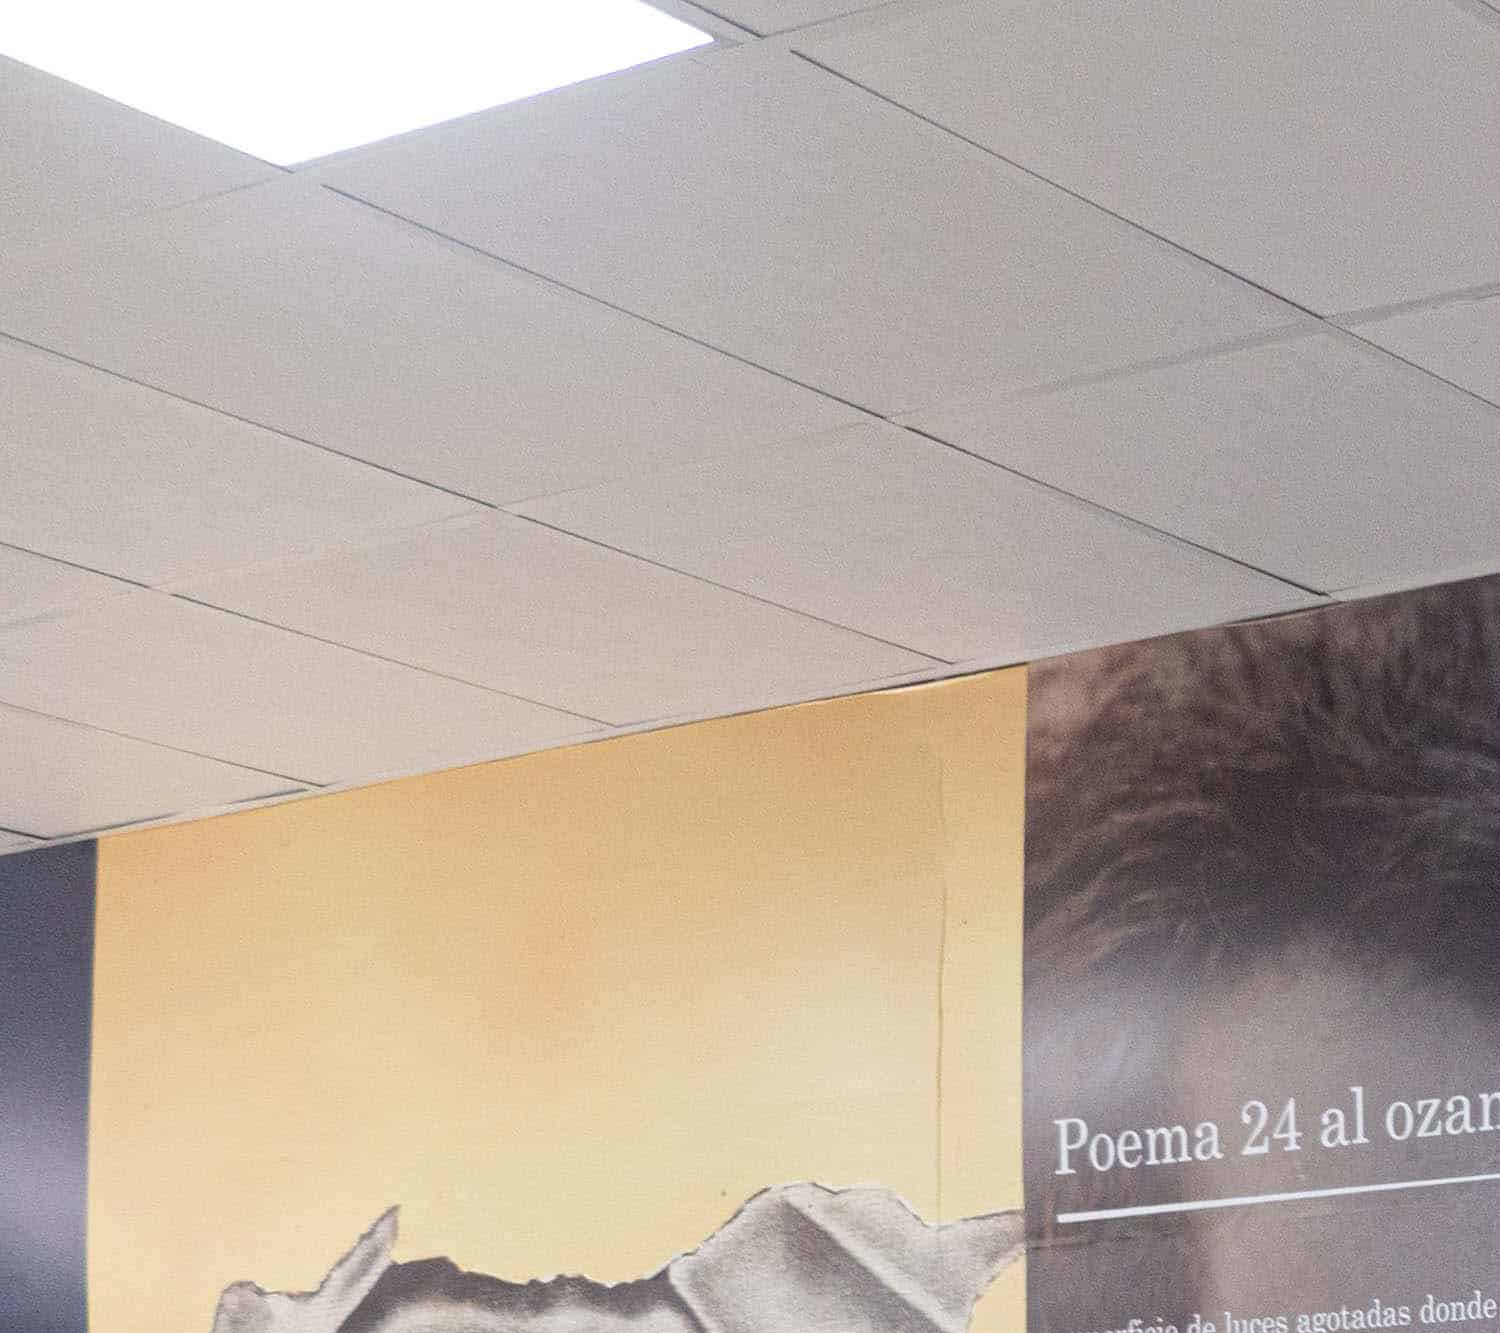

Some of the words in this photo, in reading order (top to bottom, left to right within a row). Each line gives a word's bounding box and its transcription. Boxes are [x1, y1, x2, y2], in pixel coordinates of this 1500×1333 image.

[1051, 1104, 1225, 1176] Poema
[1240, 1096, 1303, 1157] 24
[1319, 1084, 1370, 1149] al
[1418, 1288, 1498, 1325] donde
